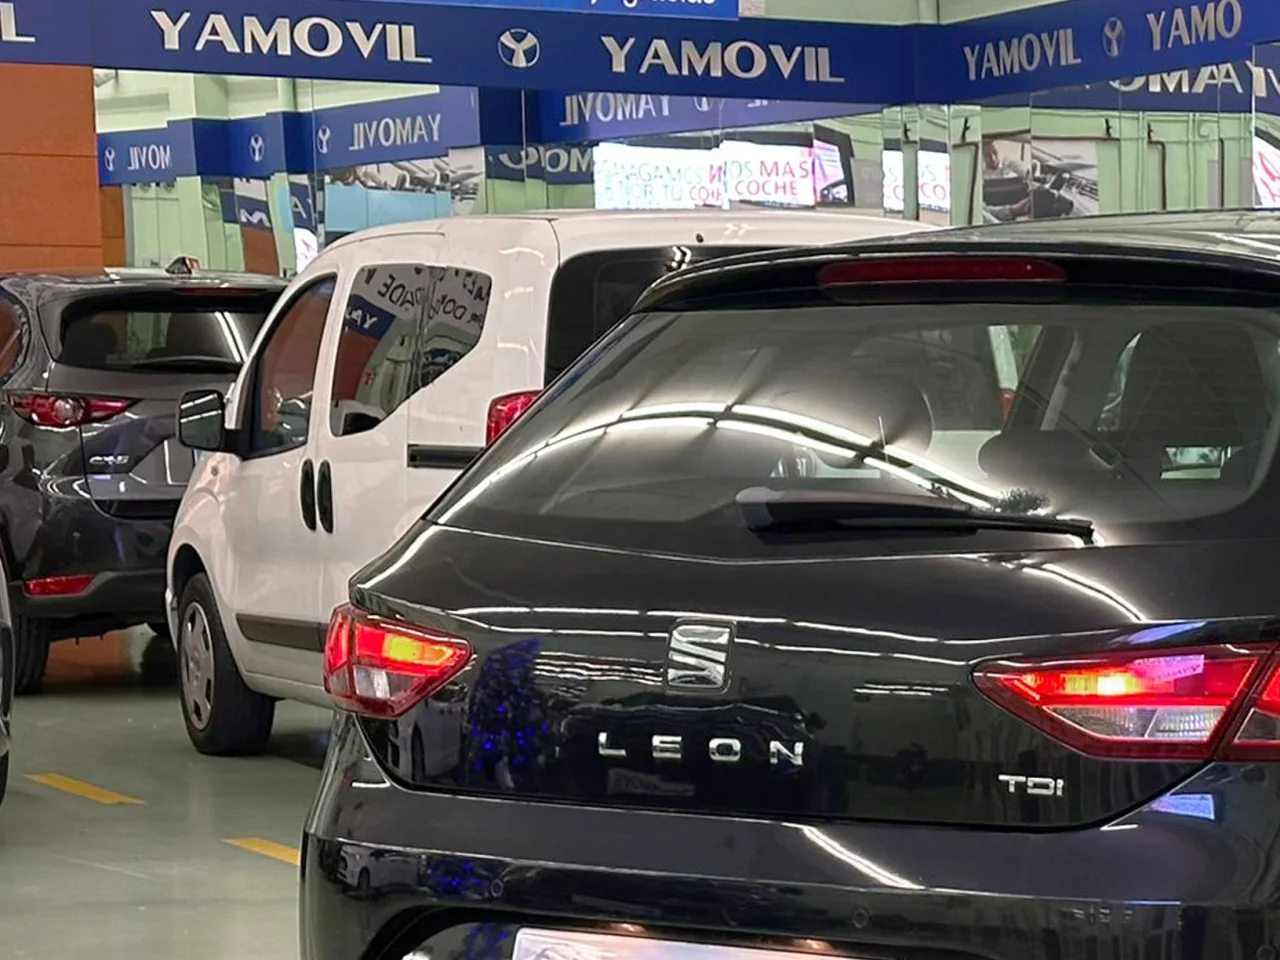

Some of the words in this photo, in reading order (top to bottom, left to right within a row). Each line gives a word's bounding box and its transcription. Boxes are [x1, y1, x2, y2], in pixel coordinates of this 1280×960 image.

[150, 10, 432, 64] YAMOVIL
[1146, 0, 1243, 50] YAMO
[600, 36, 845, 84] YAMOVIL
[963, 28, 1082, 81] YAMOVIL
[734, 180, 798, 198] COCHE
[598, 731, 805, 767] LEON
[998, 773, 1064, 797] TDI
